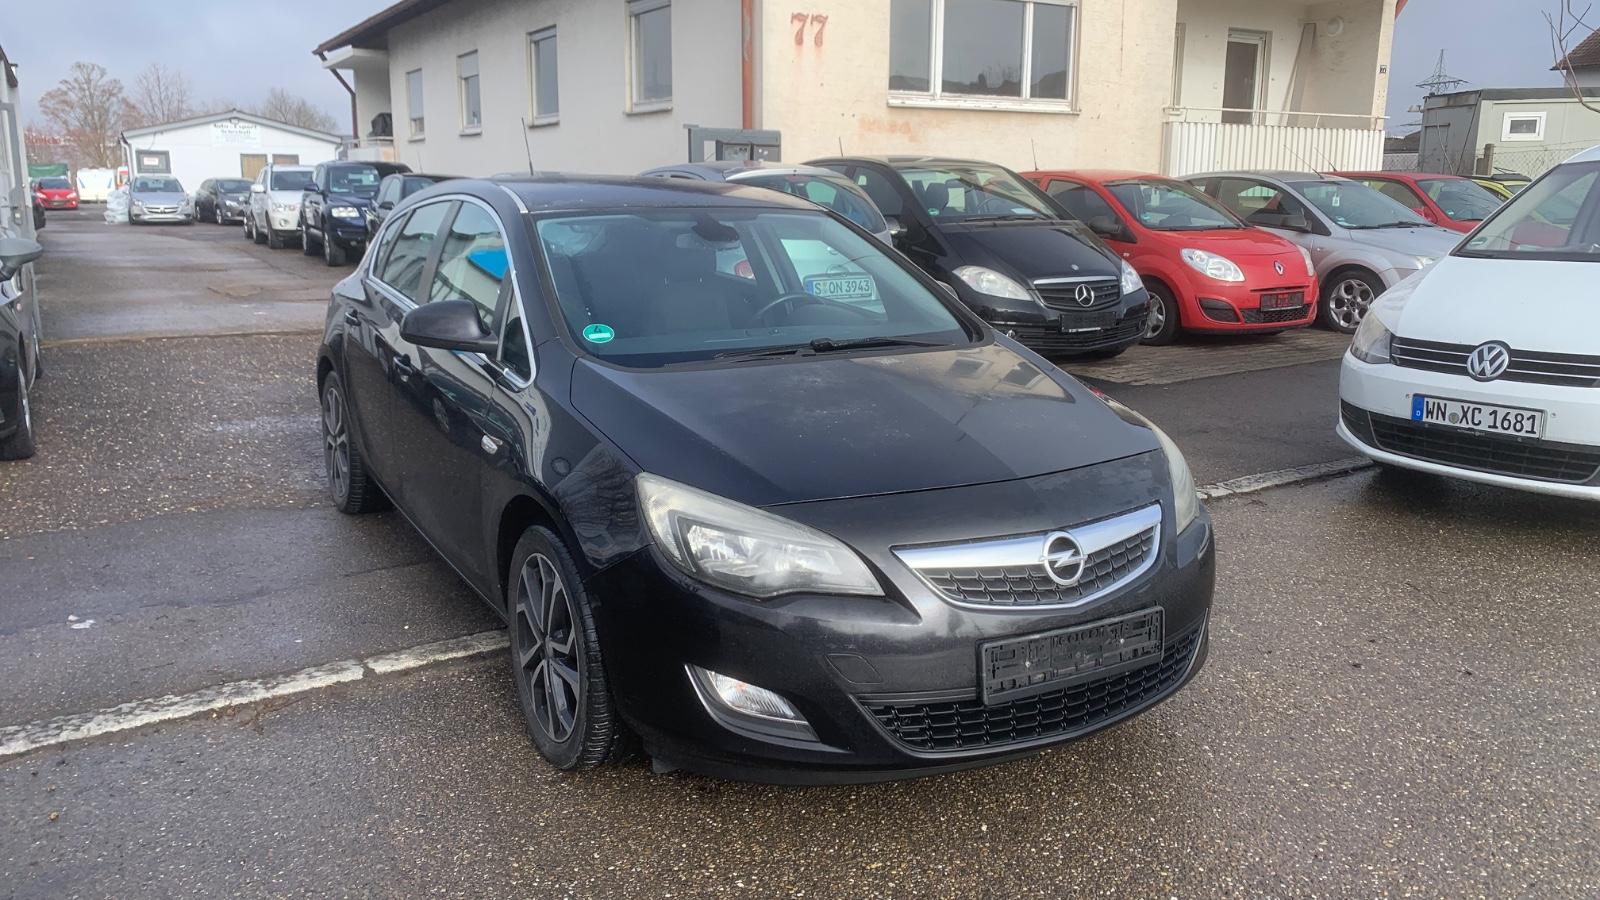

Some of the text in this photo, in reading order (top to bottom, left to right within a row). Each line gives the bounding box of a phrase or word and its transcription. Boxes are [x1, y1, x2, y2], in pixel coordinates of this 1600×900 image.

[790, 12, 829, 48] 77
[814, 280, 870, 295] S ON 3943
[1425, 400, 1447, 421] WN
[1459, 405, 1482, 426] XC
[1487, 409, 1537, 434] 1681
